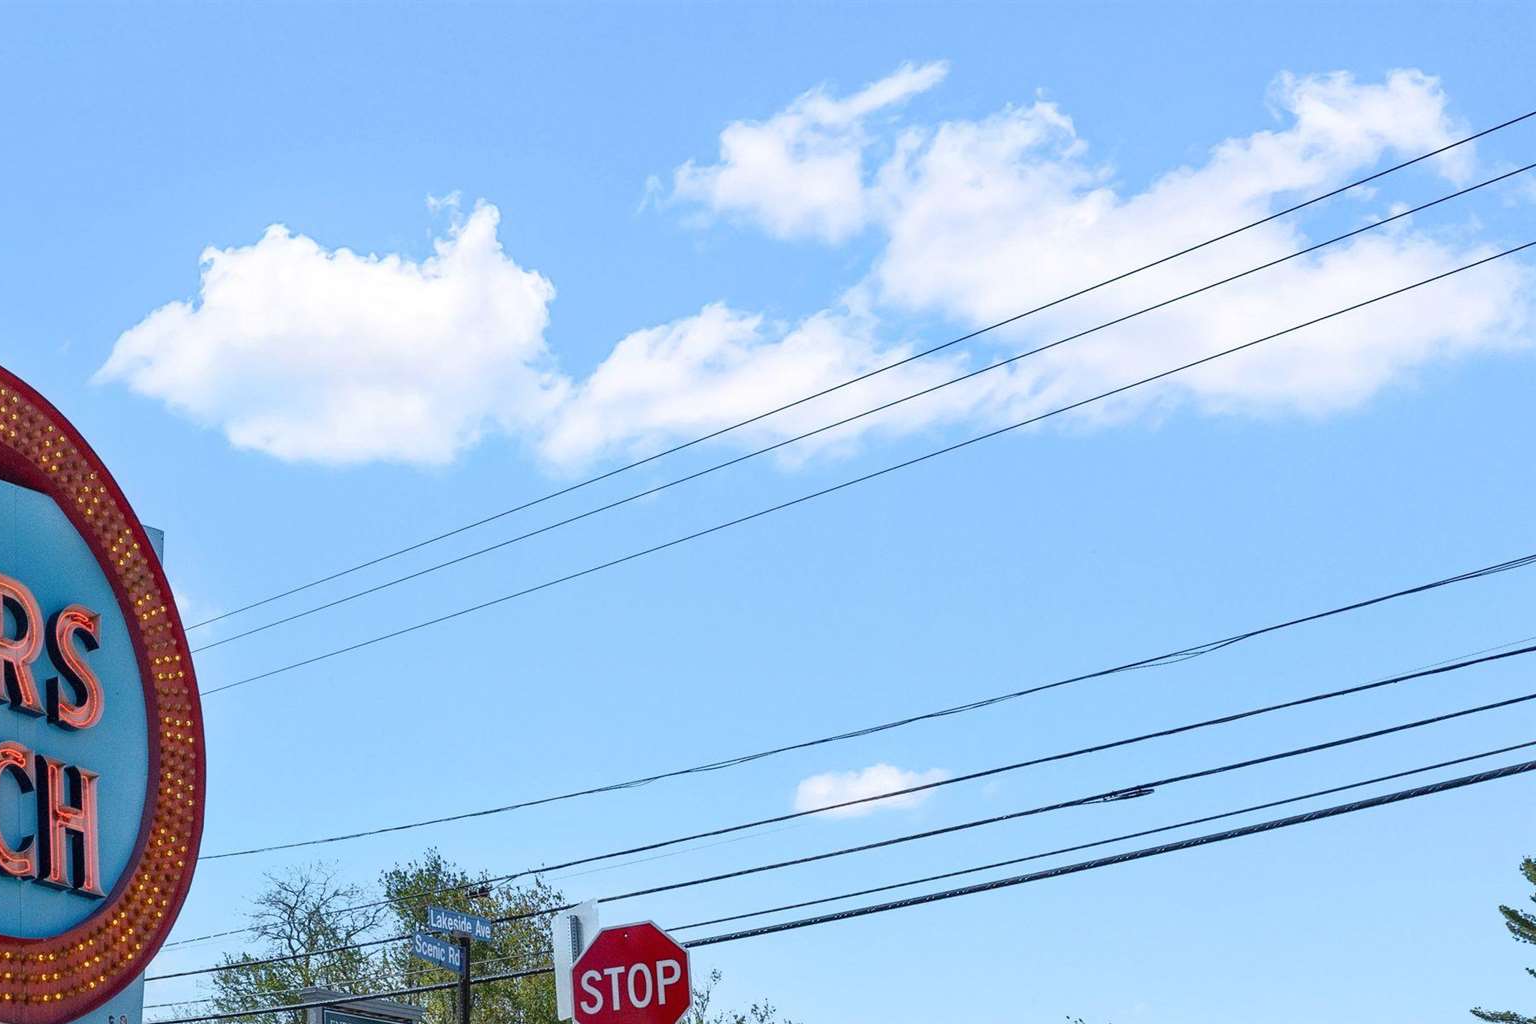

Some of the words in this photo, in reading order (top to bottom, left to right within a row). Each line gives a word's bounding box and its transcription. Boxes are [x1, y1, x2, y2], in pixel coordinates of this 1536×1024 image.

[430, 909, 472, 933] Lakeside
[475, 919, 491, 939] Ave
[415, 934, 445, 962] Scenic
[448, 946, 461, 966] Rd
[580, 959, 681, 1015] STOP
